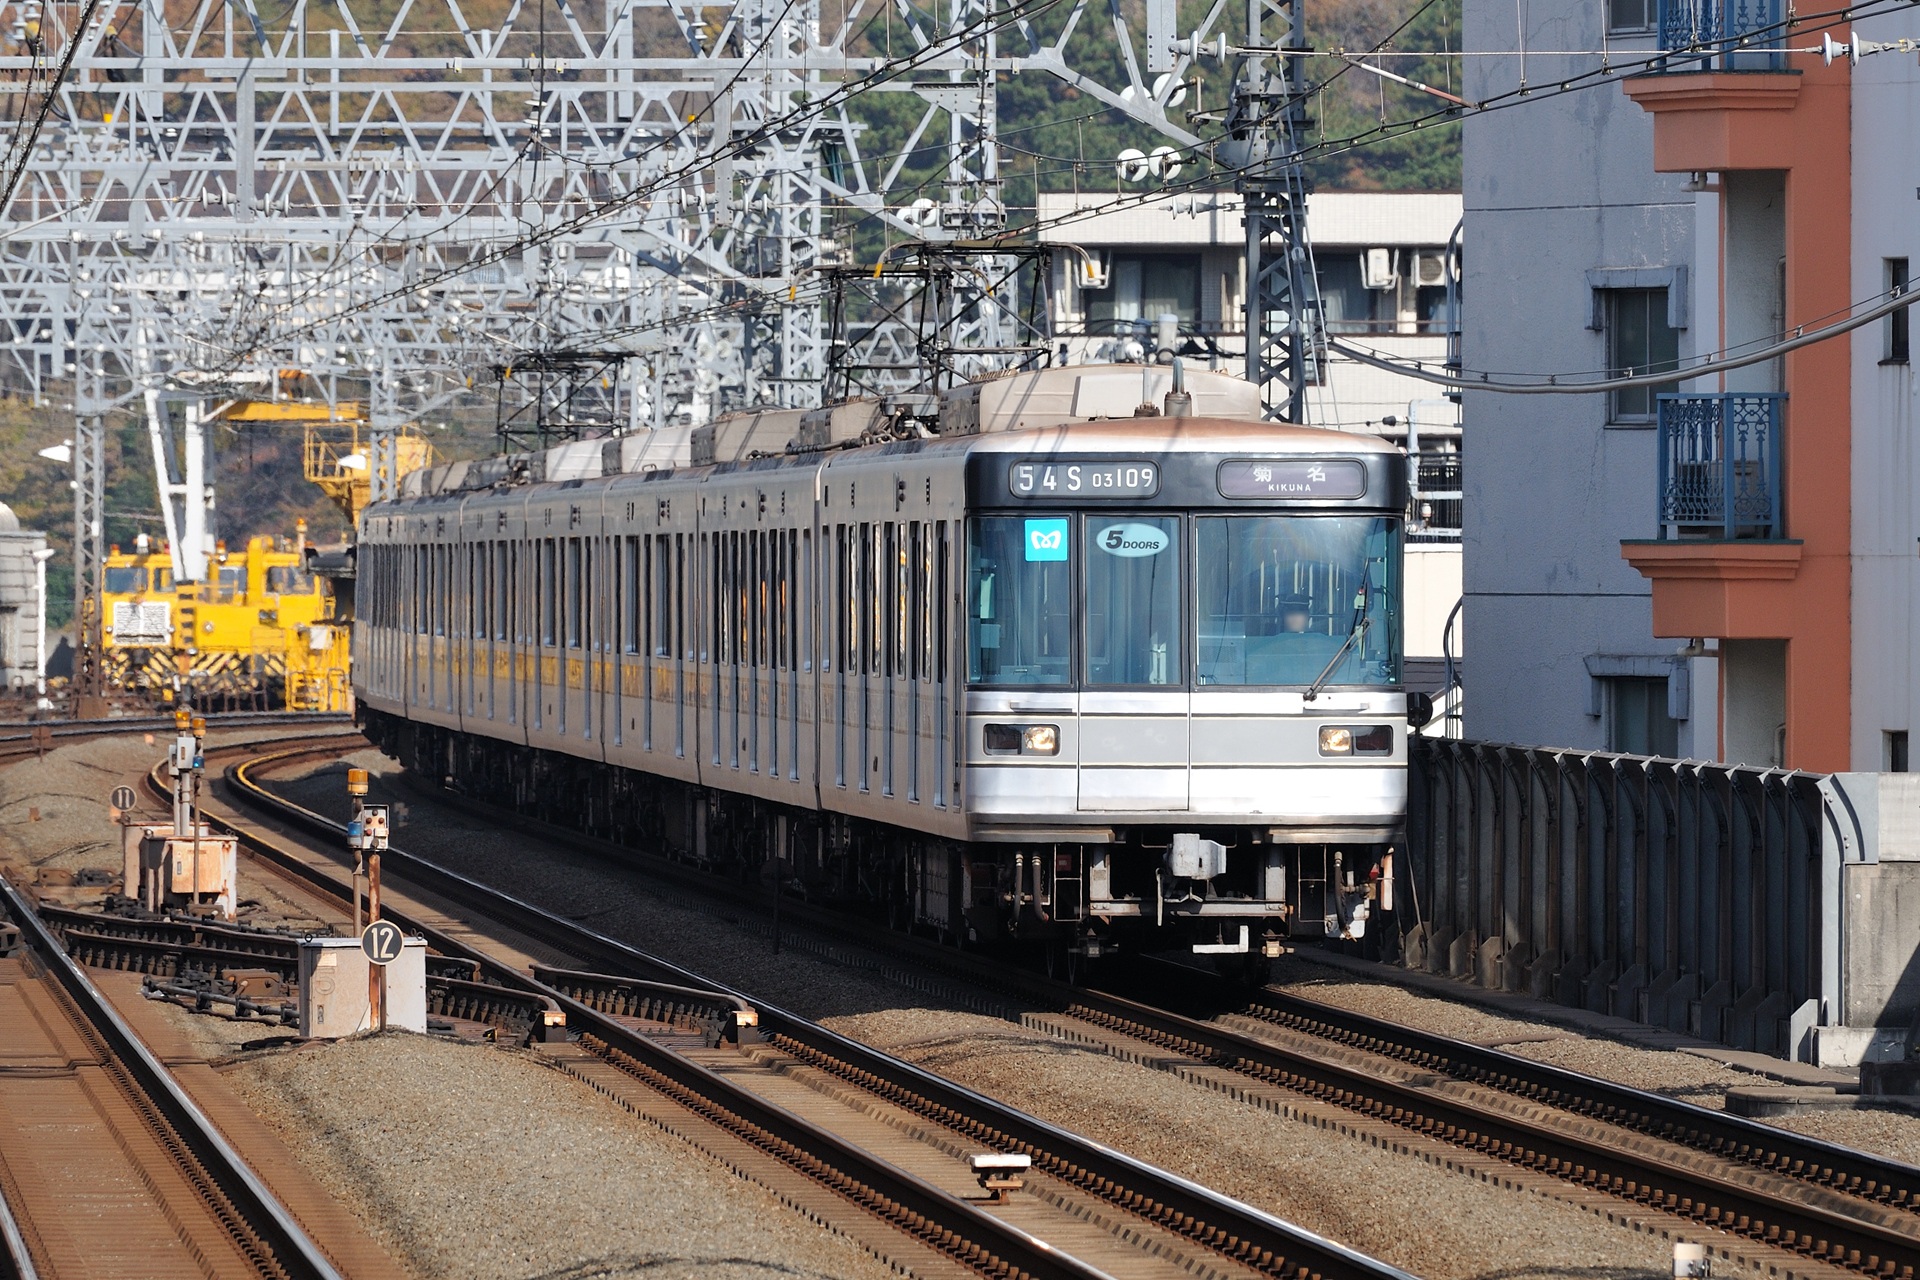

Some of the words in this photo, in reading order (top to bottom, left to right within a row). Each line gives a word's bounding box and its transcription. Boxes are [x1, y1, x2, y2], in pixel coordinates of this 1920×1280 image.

[1268, 484, 1312, 492] KIKUNA
[118, 789, 130, 808] 11
[371, 927, 395, 959] 12
